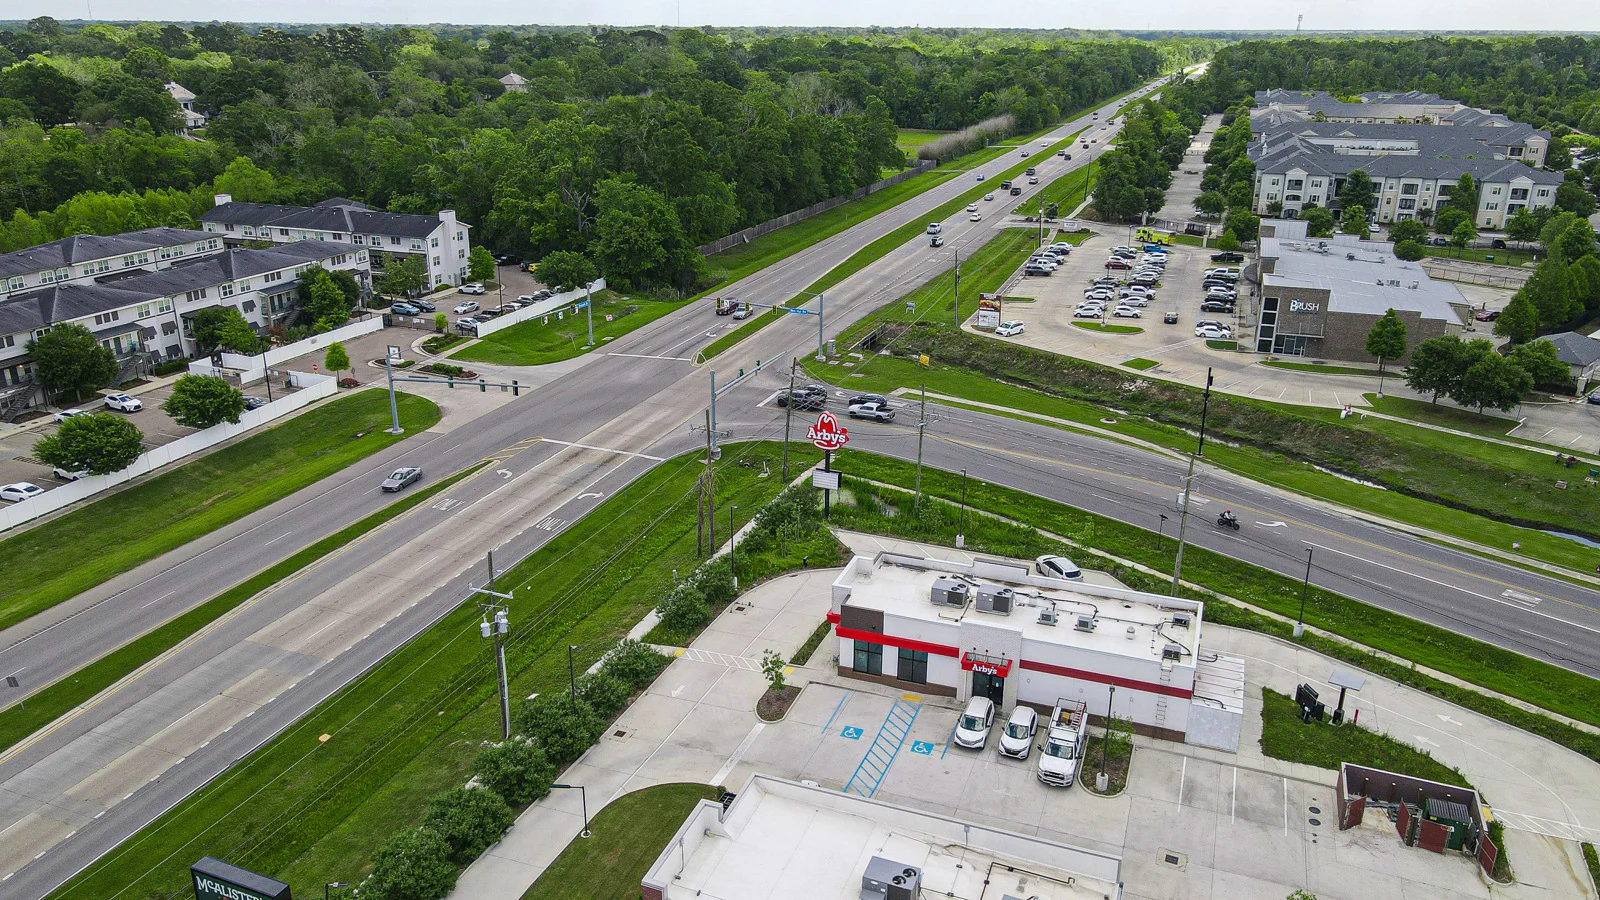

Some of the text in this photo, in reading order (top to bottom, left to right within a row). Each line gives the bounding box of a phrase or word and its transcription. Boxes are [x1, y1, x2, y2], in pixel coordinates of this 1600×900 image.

[1289, 299, 1320, 312] BRUSH
[807, 427, 846, 444] Arby's
[535, 516, 567, 532] ONLY
[972, 663, 997, 676] Arby's
